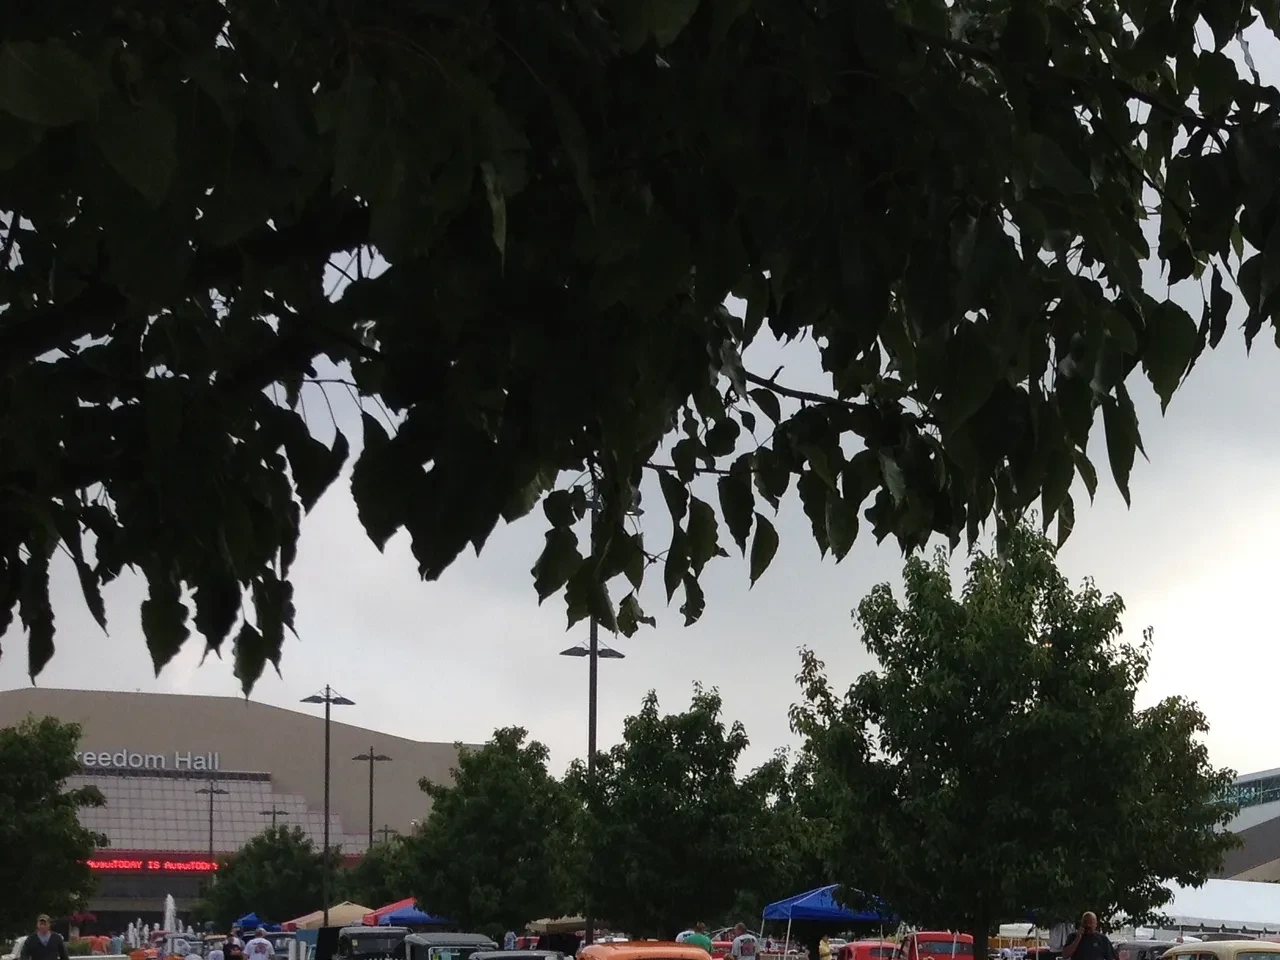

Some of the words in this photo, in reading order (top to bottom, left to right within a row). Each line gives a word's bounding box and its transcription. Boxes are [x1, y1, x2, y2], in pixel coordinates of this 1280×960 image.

[74, 749, 166, 769] reedom
[175, 751, 220, 770] Hall
[148, 861, 160, 869] IS
